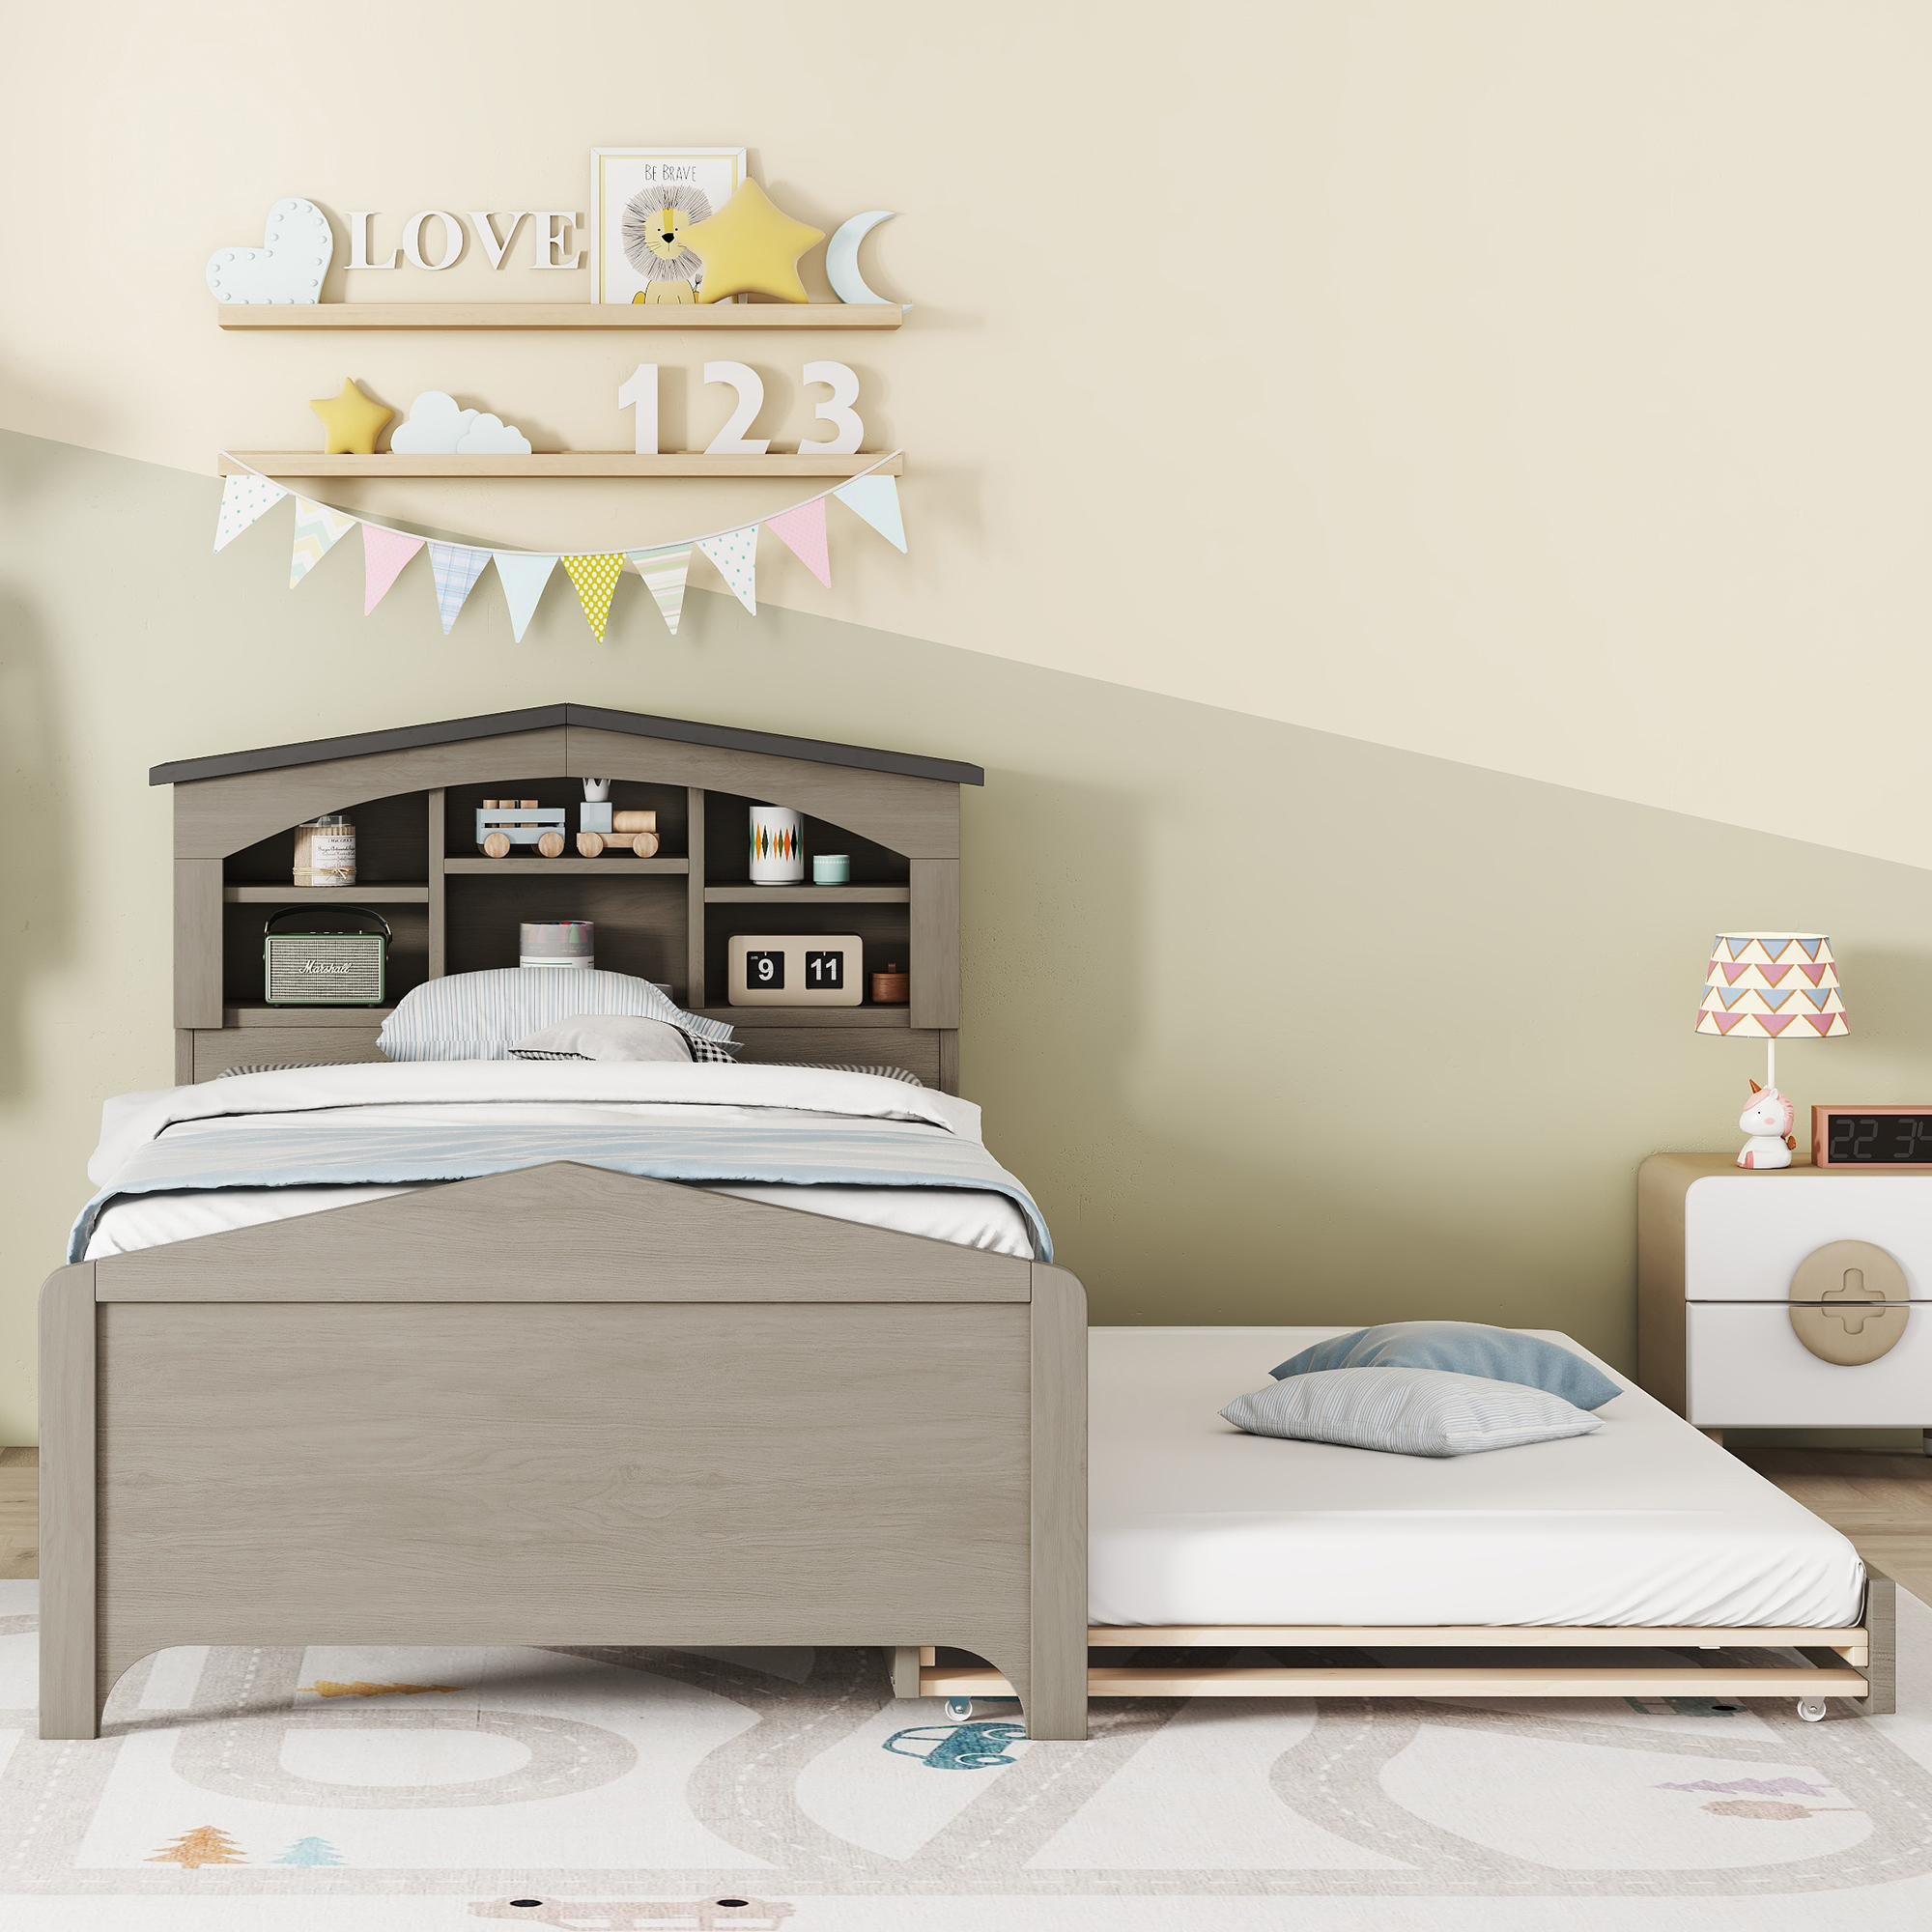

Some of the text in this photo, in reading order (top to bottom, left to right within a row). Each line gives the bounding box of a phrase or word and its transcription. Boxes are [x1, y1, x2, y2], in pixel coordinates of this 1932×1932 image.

[644, 163, 696, 183] BE BRAVE
[344, 211, 581, 270] LOVE
[298, 959, 354, 974] Marshall
[758, 958, 837, 980] 9 11
[1830, 1119, 1879, 1159] 22
